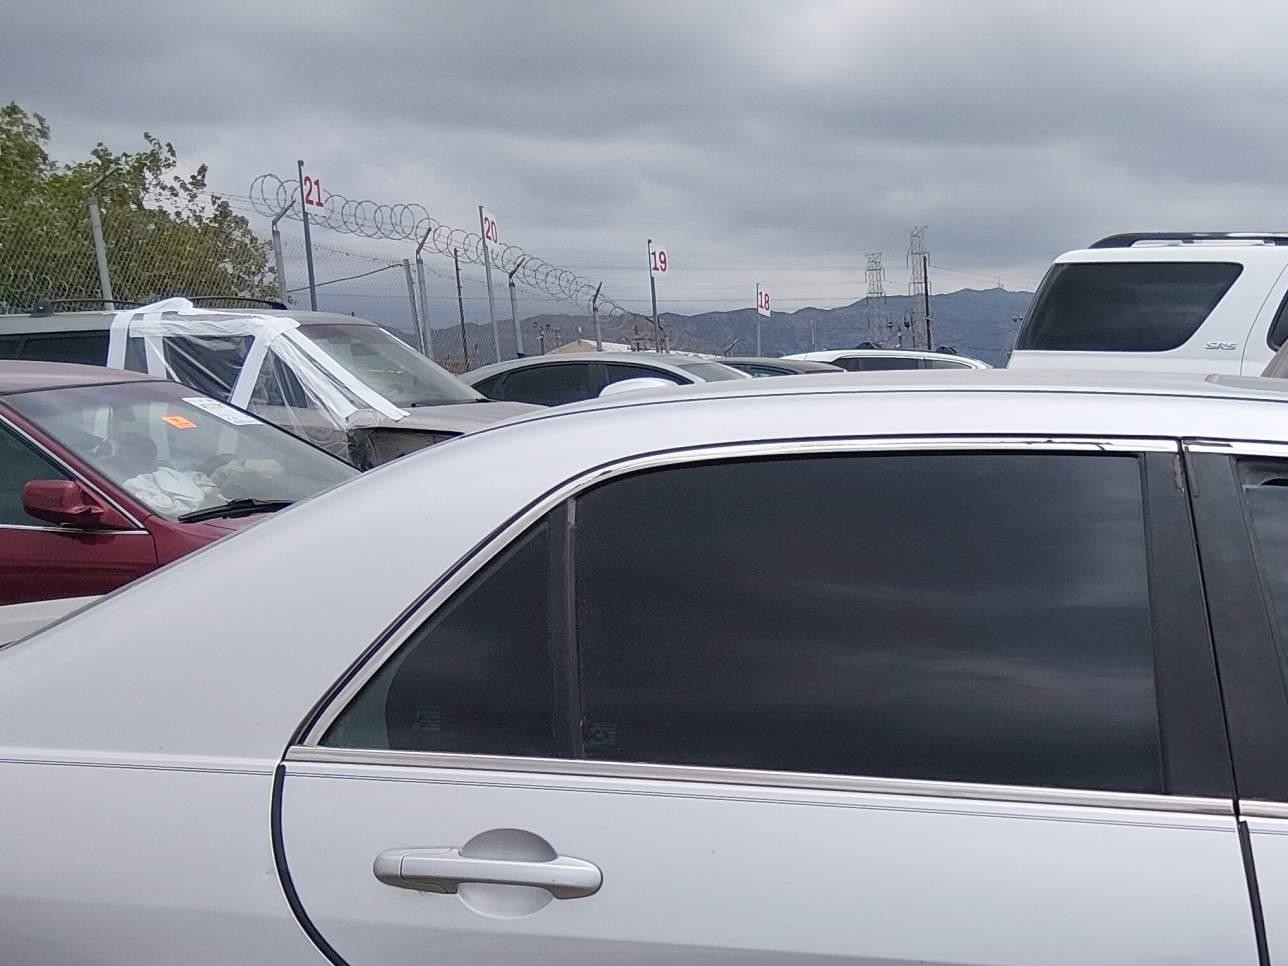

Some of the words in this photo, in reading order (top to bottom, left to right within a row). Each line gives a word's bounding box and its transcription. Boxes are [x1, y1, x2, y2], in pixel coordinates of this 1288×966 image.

[303, 175, 324, 208] 21
[483, 216, 498, 244] 20
[651, 250, 667, 272] 19
[758, 291, 770, 311] 18
